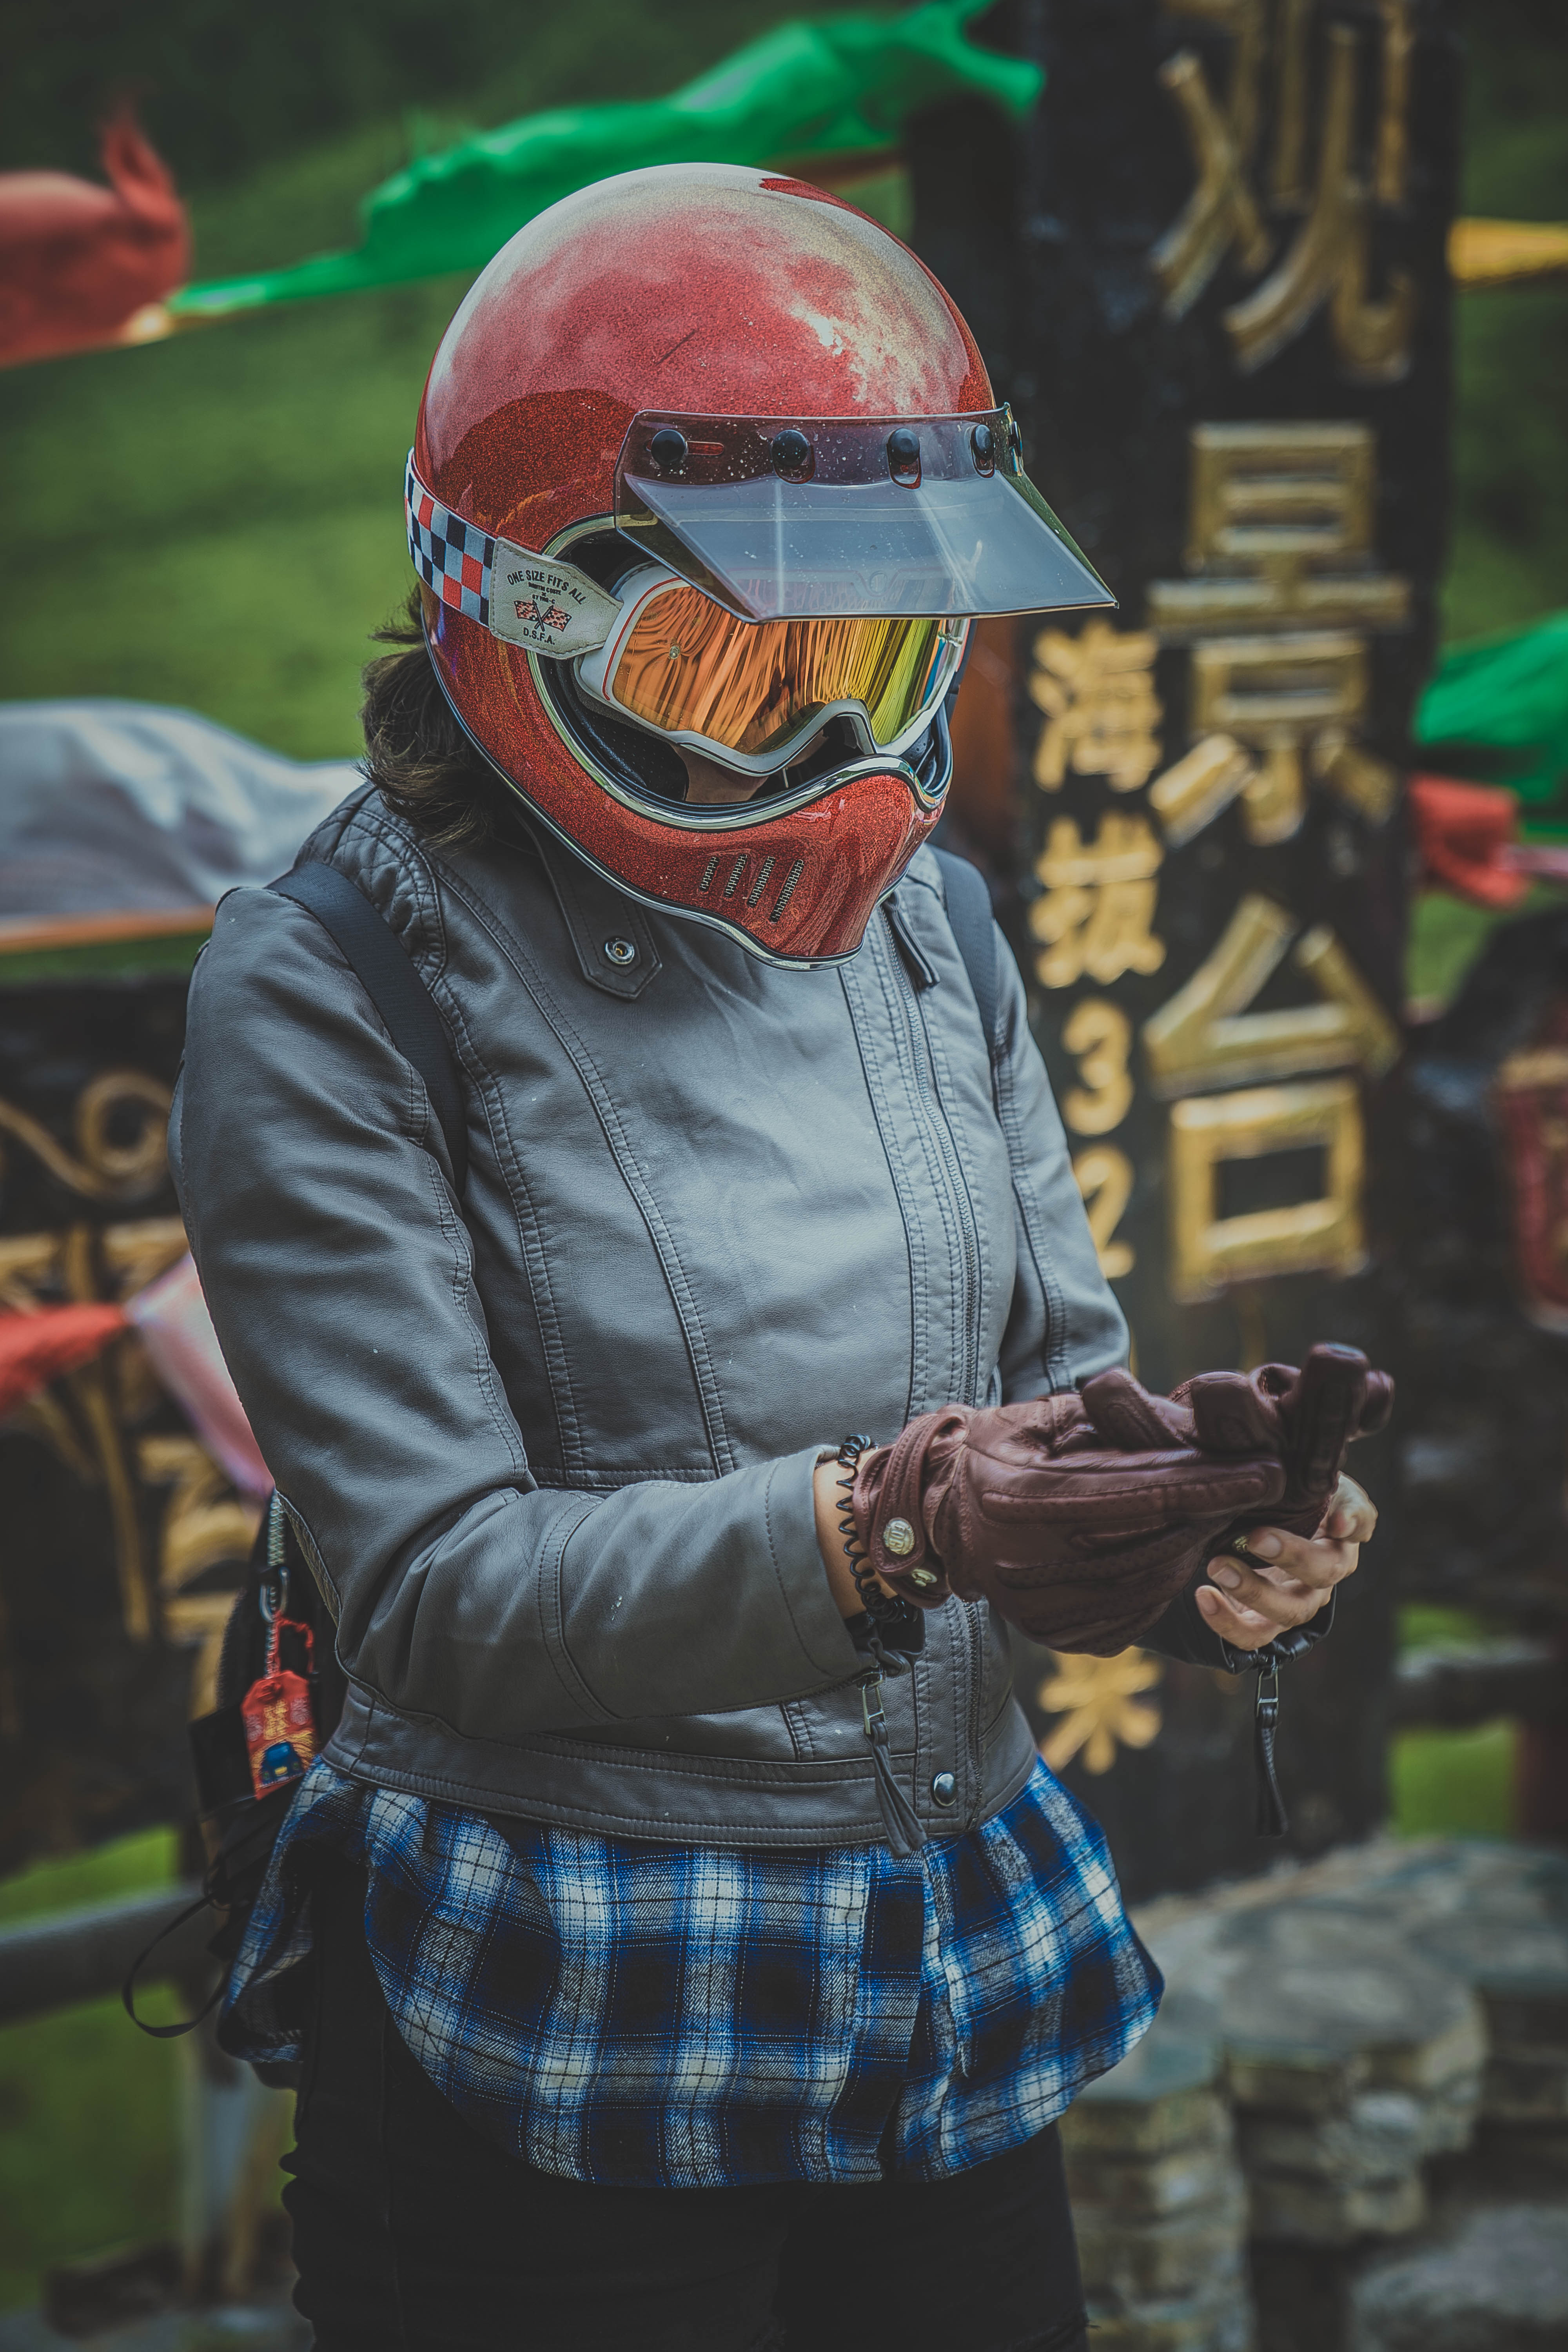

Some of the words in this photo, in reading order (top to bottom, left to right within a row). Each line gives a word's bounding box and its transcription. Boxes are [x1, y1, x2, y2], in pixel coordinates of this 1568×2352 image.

[507, 570, 524, 585] ONE
[526, 570, 544, 582] SIZE
[547, 574, 569, 591] FITS
[568, 588, 586, 604] ALL
